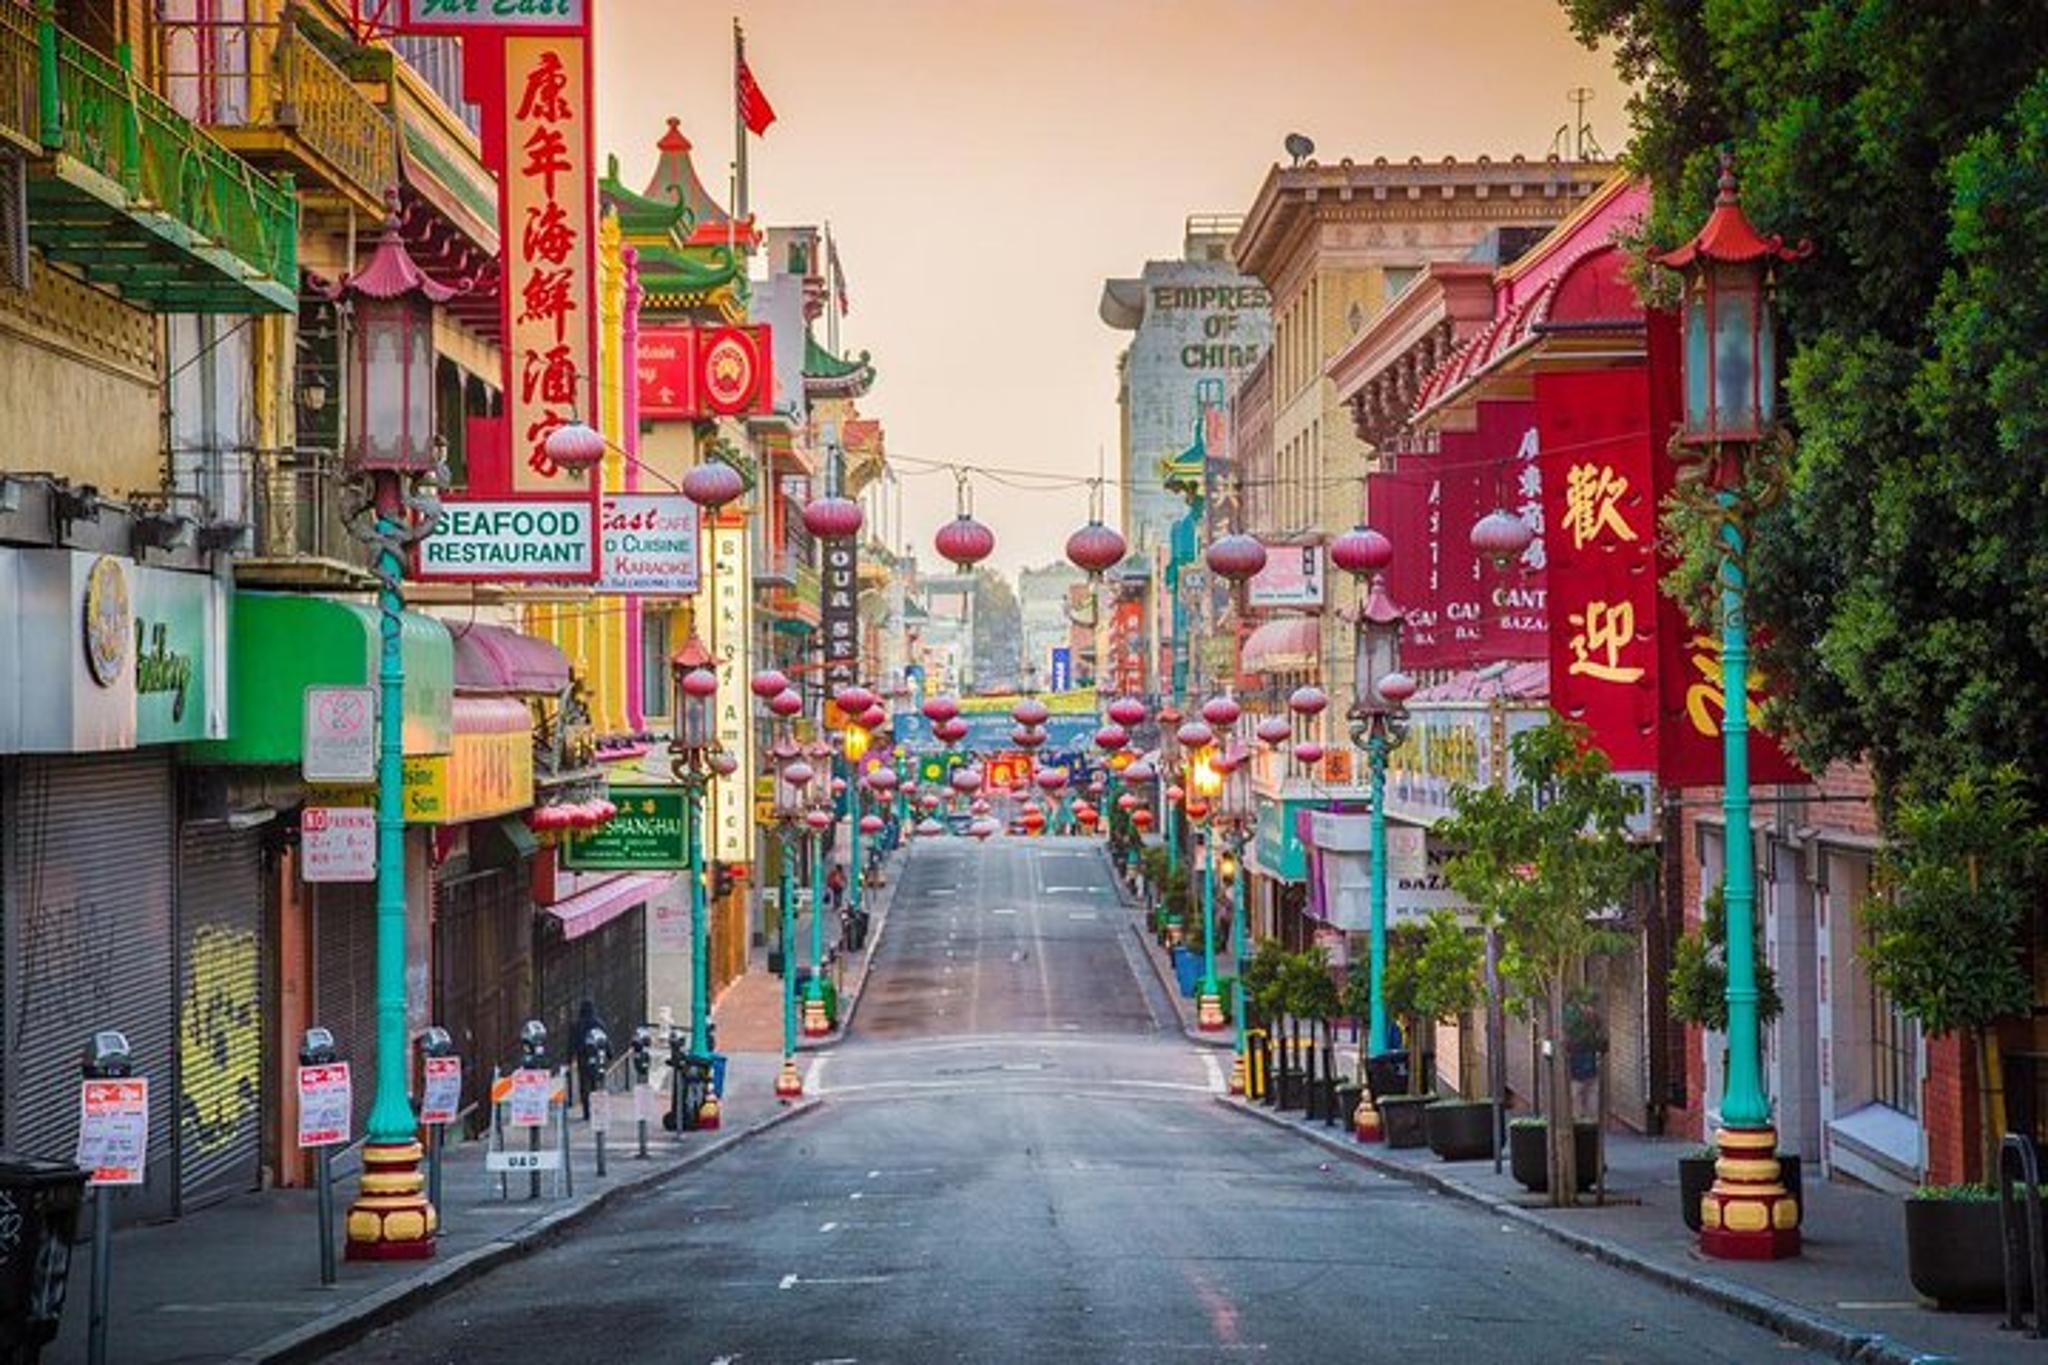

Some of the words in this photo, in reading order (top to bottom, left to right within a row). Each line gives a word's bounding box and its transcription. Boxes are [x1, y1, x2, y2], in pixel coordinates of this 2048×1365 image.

[1153, 286, 1272, 311] EMPRES
[1204, 315, 1238, 338] OF
[432, 511, 580, 536] SEAFOOD
[428, 542, 586, 563] RESTAURANT
[1561, 462, 1646, 683] 歡迎
